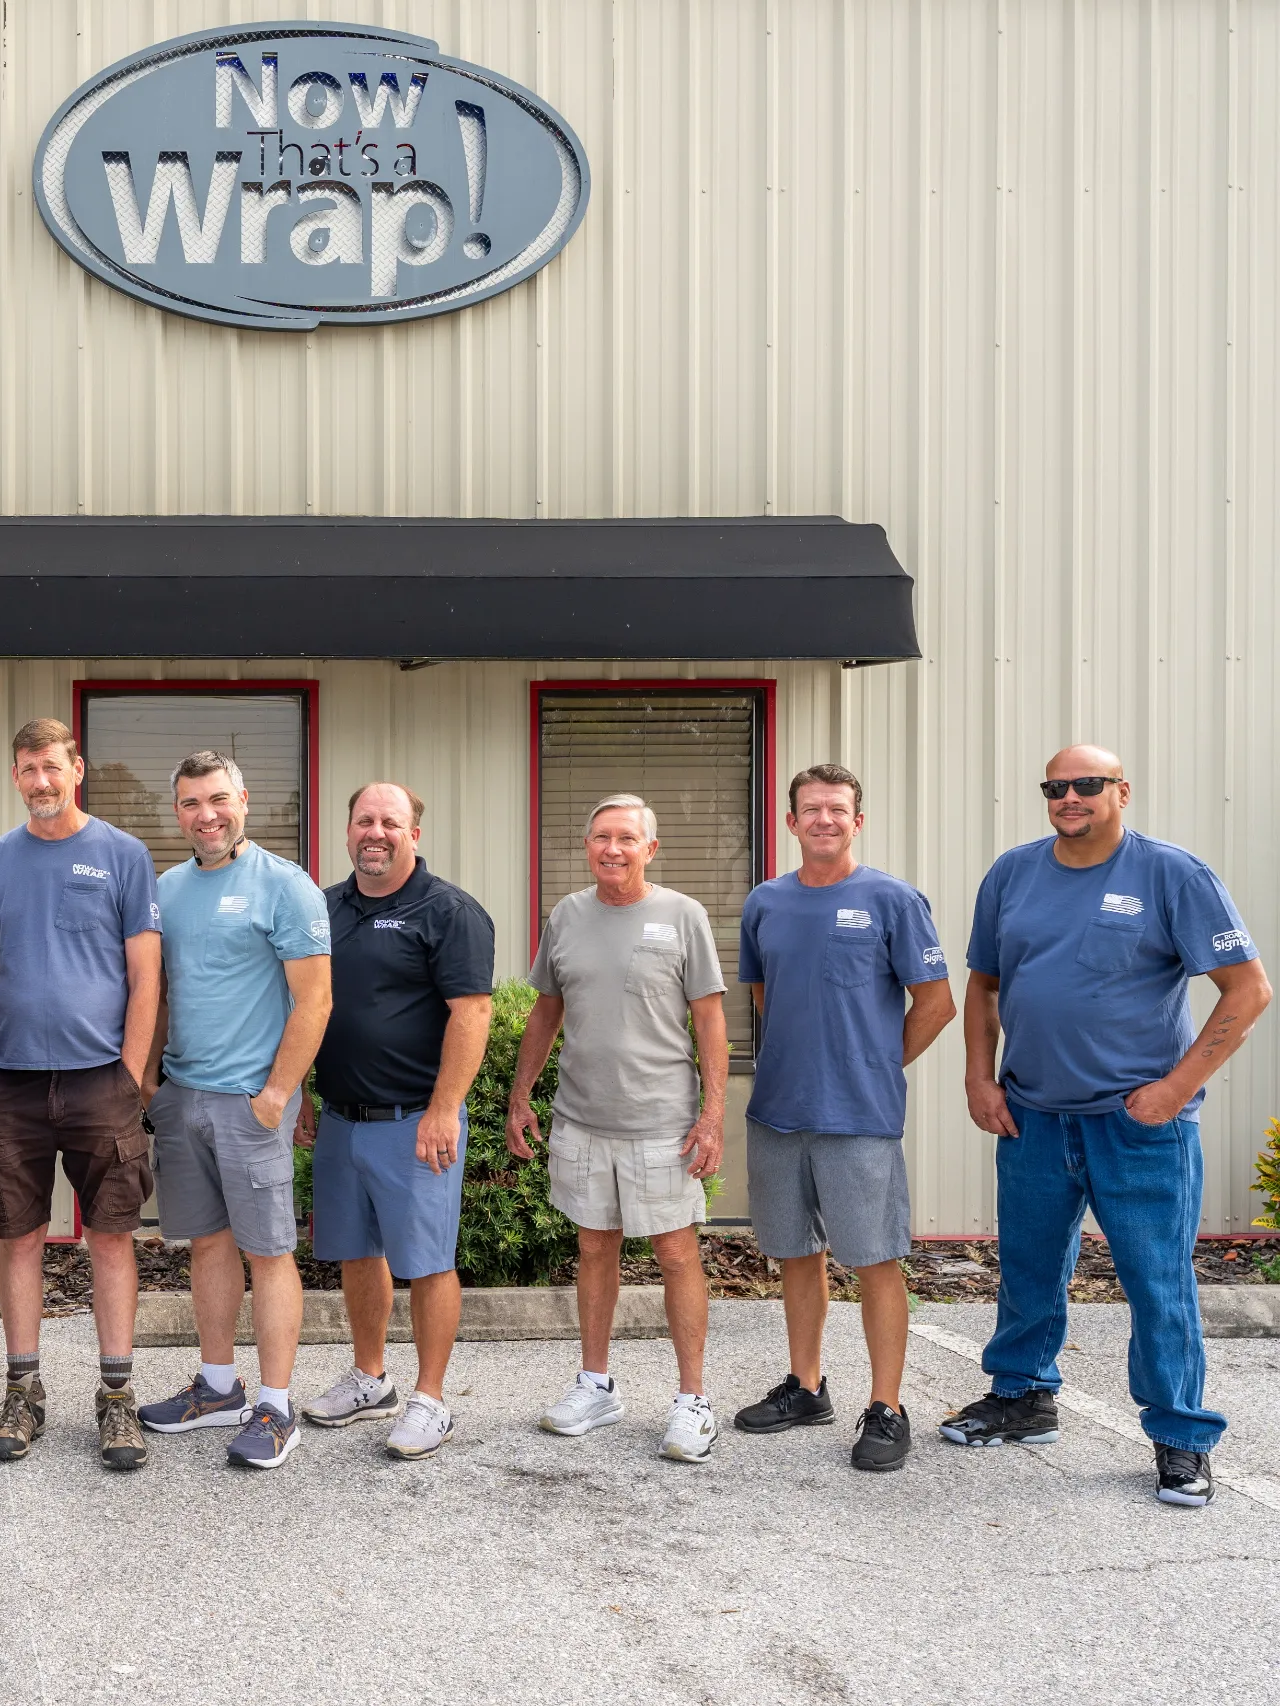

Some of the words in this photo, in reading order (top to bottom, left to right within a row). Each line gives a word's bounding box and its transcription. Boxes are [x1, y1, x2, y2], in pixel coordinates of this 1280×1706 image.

[215, 51, 430, 130] Now
[246, 129, 379, 177] That's
[393, 146, 418, 177] a
[101, 99, 492, 297] Wrap!
[1214, 937, 1244, 951] Signs
